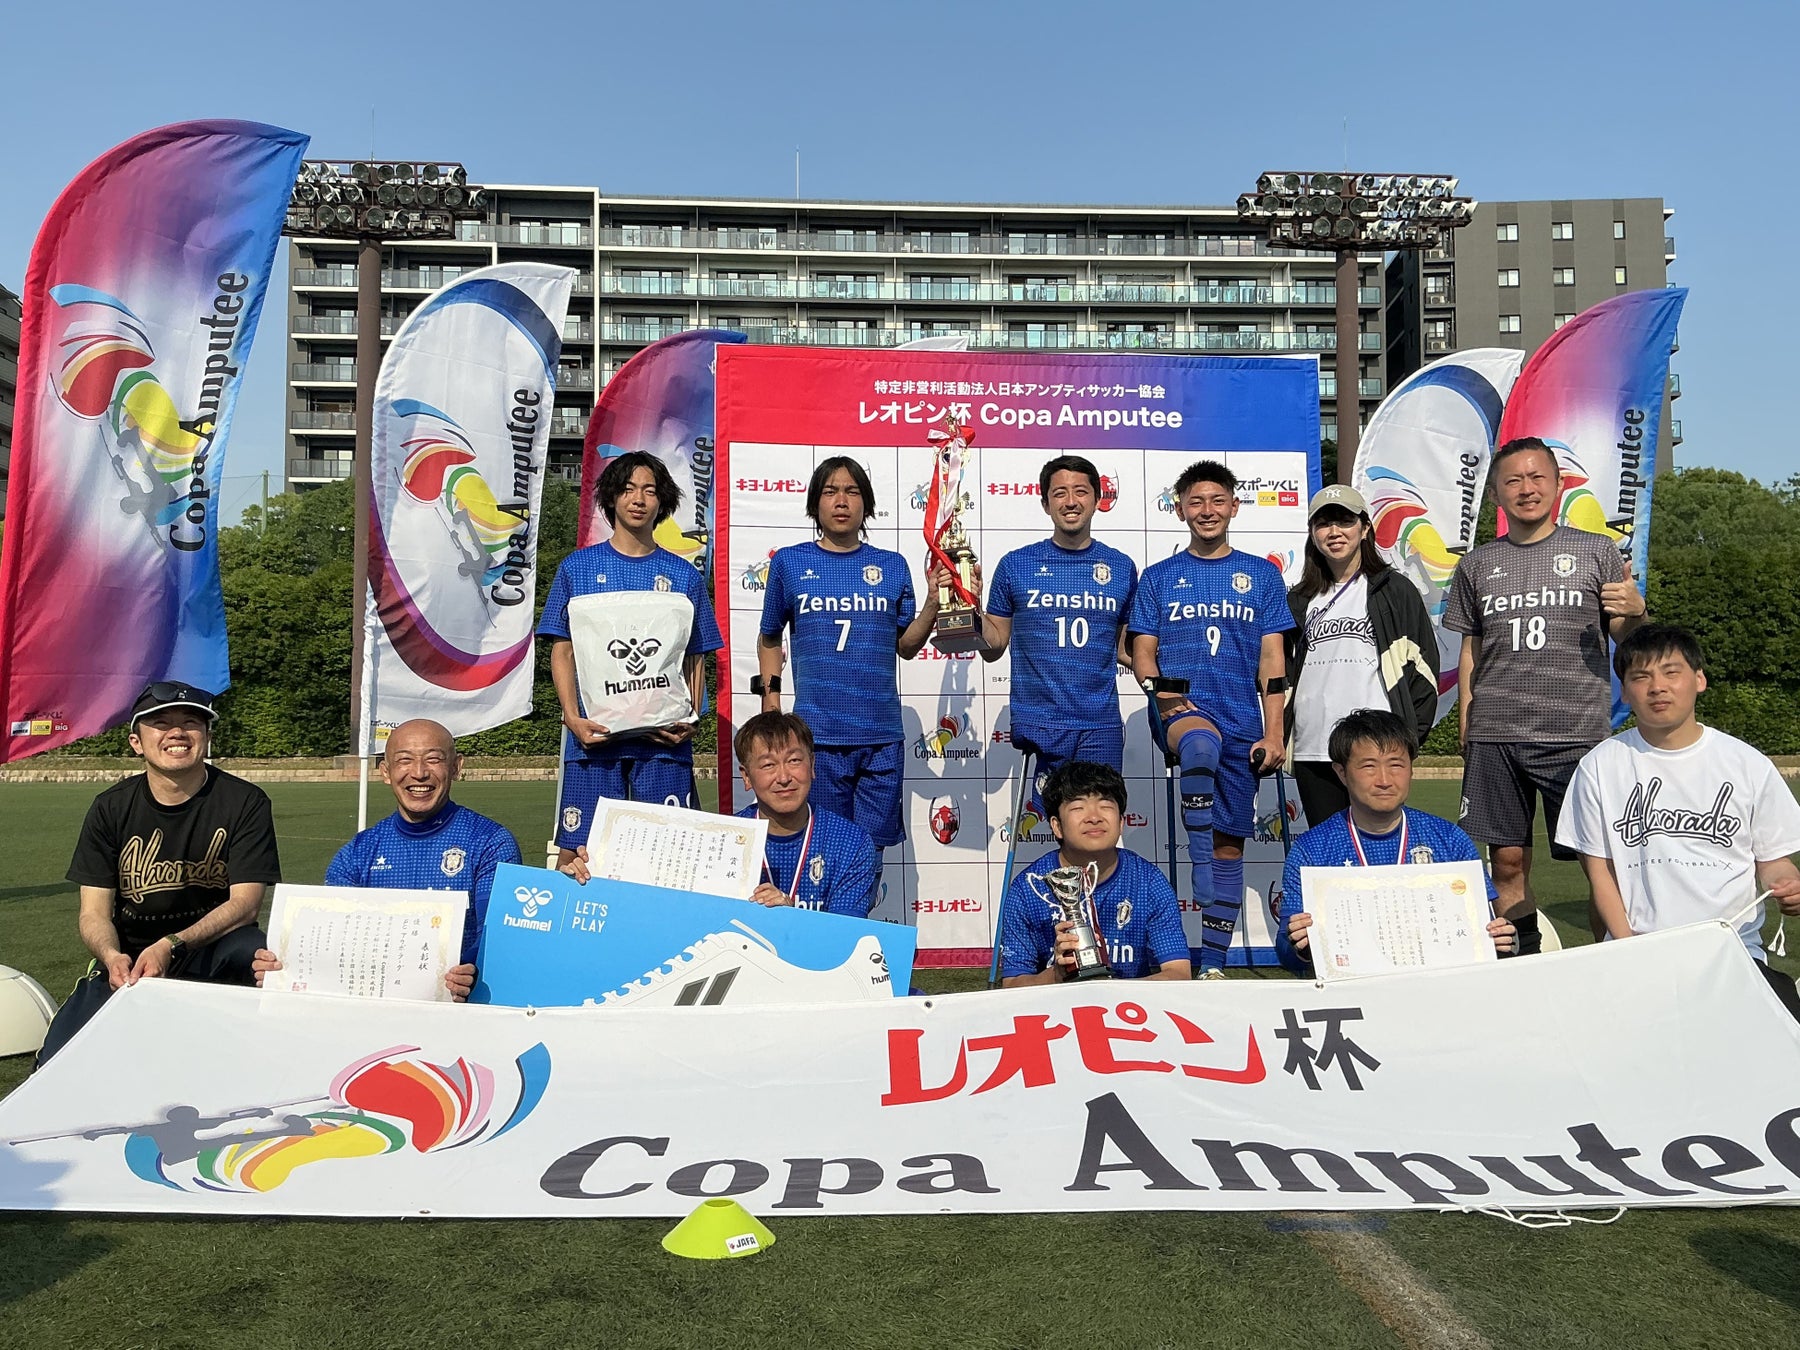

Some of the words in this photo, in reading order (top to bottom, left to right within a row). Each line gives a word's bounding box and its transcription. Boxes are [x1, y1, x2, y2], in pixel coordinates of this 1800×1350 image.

[178, 272, 249, 436] Amputee
[874, 379, 1166, 399] 特定非営利活動法人日本アンプティサッカー協会
[859, 400, 972, 425] レオピン杯
[980, 404, 1052, 429] Copa
[1057, 404, 1183, 431] Amputee
[496, 388, 541, 528] Amputee
[681, 436, 714, 545] Amputee
[1237, 477, 1299, 491] スポーツくじ
[1606, 408, 1647, 541] Amputee
[169, 443, 210, 552] Copa
[491, 532, 532, 607] Copa
[797, 593, 888, 614] Zenshin
[1026, 589, 1117, 612] Zenshin
[1168, 599, 1255, 623] Zenshin
[1481, 585, 1583, 617] Zenshin
[834, 619, 851, 651] 7
[1054, 616, 1090, 648] 10
[1205, 625, 1221, 657] 9
[1508, 615, 1547, 652] 18
[605, 673, 671, 697] hummel
[914, 745, 937, 760] Copa
[940, 745, 979, 759] Amputee
[1613, 776, 1741, 847] Alvorada
[119, 828, 228, 904] Alvorada
[503, 913, 552, 932] hummel
[574, 900, 609, 917] LET'S
[911, 900, 982, 913] キヨーレオピン
[571, 918, 606, 934] PLAY
[881, 1004, 1381, 1106] レオピン杯
[540, 1136, 1001, 1209] Copa
[736, 1236, 756, 1248] JAFA
